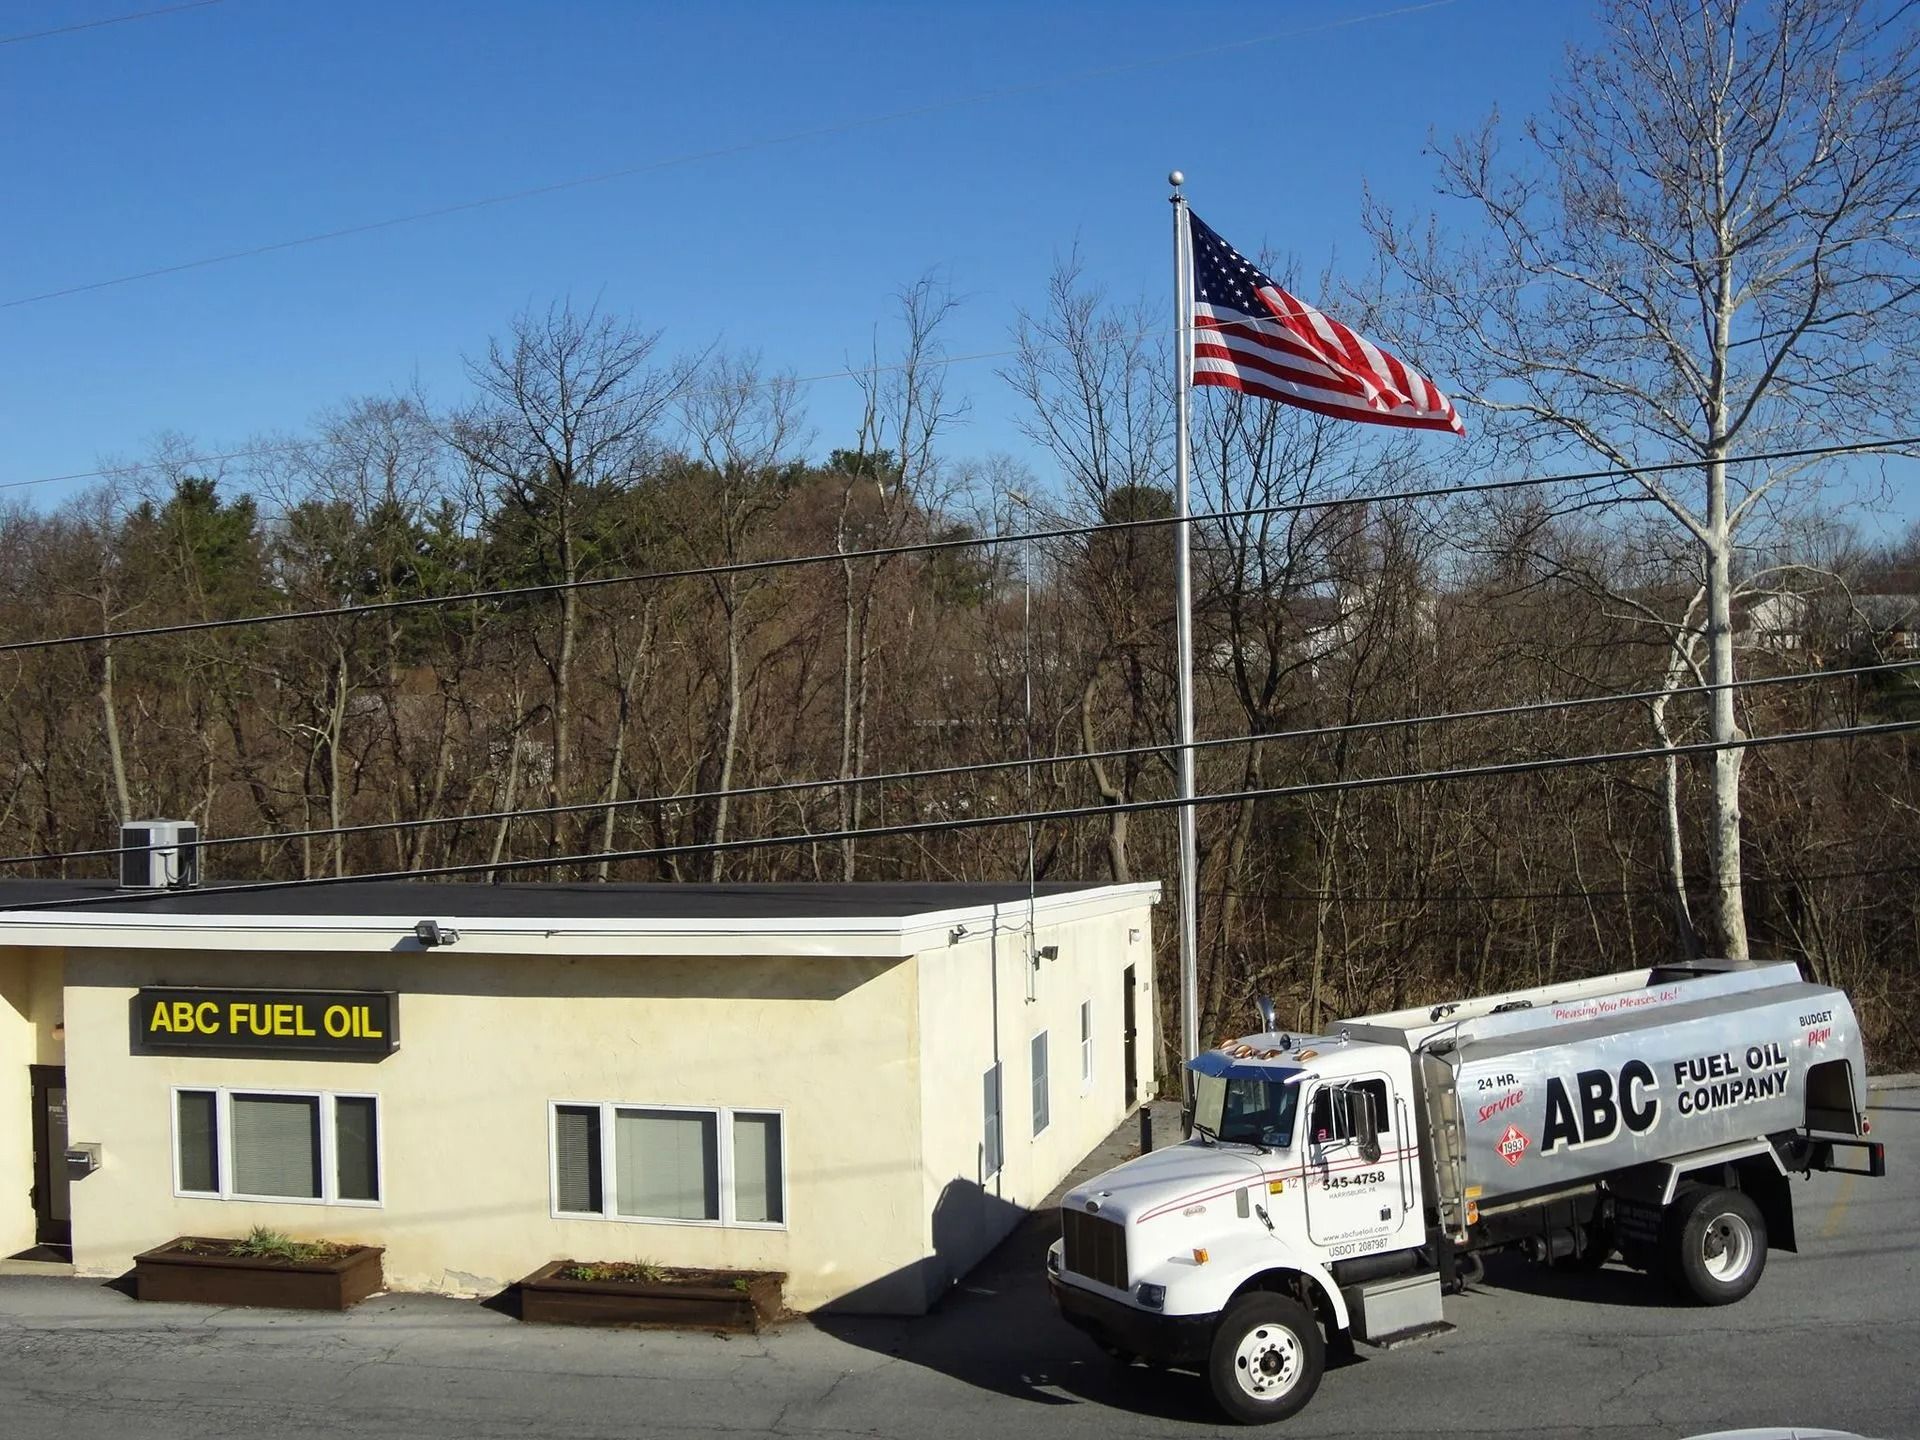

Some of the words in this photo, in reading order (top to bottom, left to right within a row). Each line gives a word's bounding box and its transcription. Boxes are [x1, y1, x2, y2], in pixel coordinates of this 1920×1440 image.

[1599, 1001, 1617, 1012] You
[1619, 997, 1657, 1009] Pleases
[150, 1001, 220, 1034] ABC
[229, 1003, 316, 1036] FUEL
[323, 1005, 383, 1038] OIL
[1799, 1010, 1832, 1027] BUDGET
[1808, 1028, 1831, 1049] Plan
[1673, 1053, 1741, 1090] FUEL
[1745, 1042, 1790, 1073] OIL
[1478, 1078, 1493, 1091] 24
[1496, 1073, 1520, 1088] HR.
[1678, 1070, 1790, 1119] COMPANY
[1477, 1088, 1524, 1124] Service
[1540, 1059, 1661, 1156] ABC
[1503, 1140, 1523, 1155] 1993
[1287, 1177, 1298, 1189] 12
[1323, 1171, 1385, 1191] 545-4758
[1323, 1225, 1389, 1242] www.abcfueloil.com
[1328, 1244, 1356, 1258] USDOT
